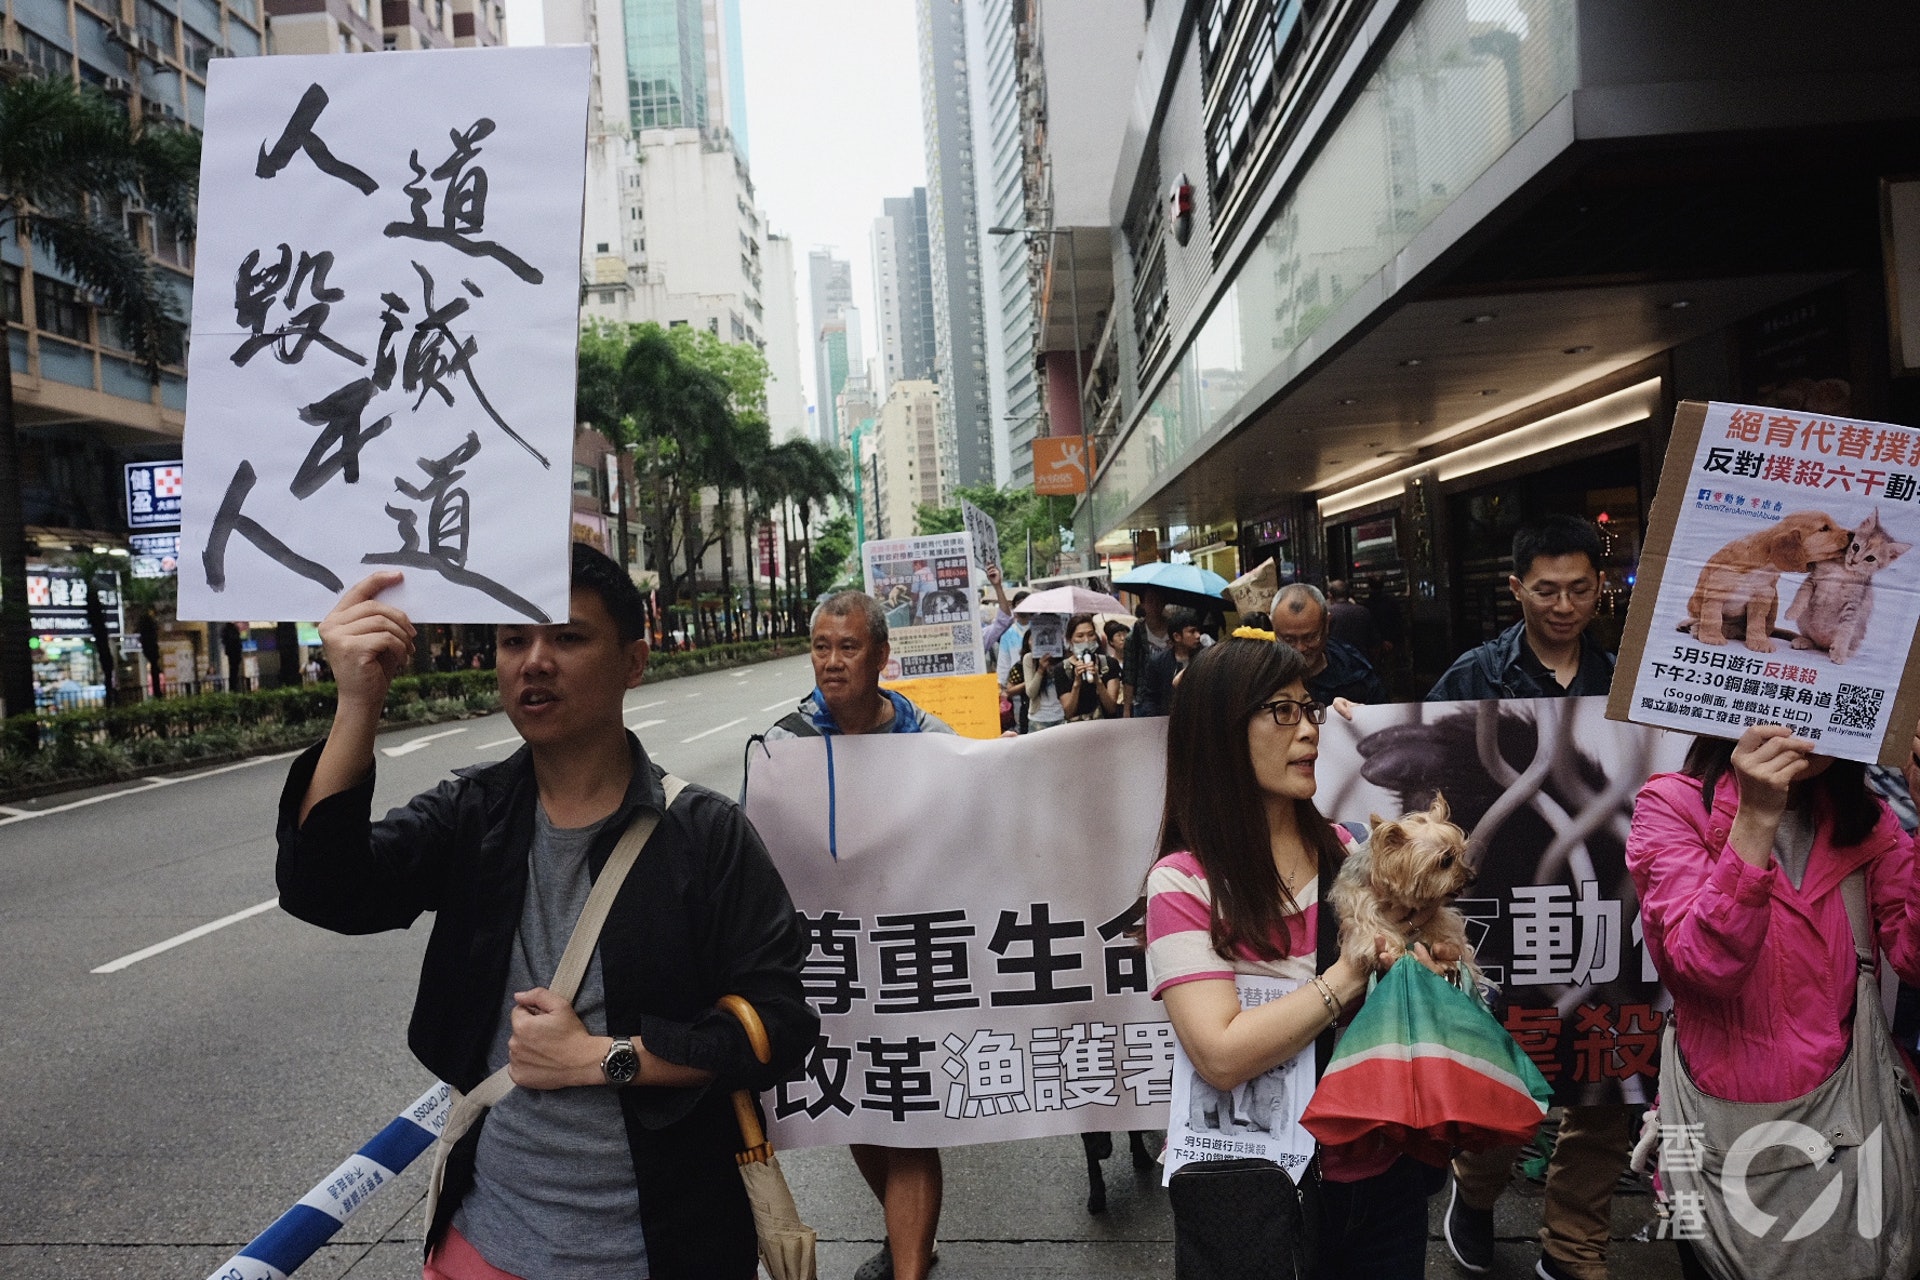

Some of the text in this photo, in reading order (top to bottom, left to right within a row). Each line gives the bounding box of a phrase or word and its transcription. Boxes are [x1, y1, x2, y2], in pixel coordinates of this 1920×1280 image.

[255, 82, 544, 285] 人道
[229, 242, 551, 470] 毀滅
[289, 377, 399, 500] 不
[202, 430, 552, 625] 人道
[1695, 501, 1781, 521] fb.com/ZeroAnimalAbuse
[1672, 646, 1818, 685] 5月5日遊行反撲殺
[1651, 662, 1833, 709] 下午2:30銅鑼灣東角道
[1641, 696, 1741, 725] 獨立動物義工發起
[1731, 697, 1771, 718] 地鐵站
[1772, 705, 1781, 718] E
[1782, 706, 1813, 723] 出口)
[1827, 725, 1873, 739] bit.ly/antikill
[412, 1095, 440, 1122] CROSS
